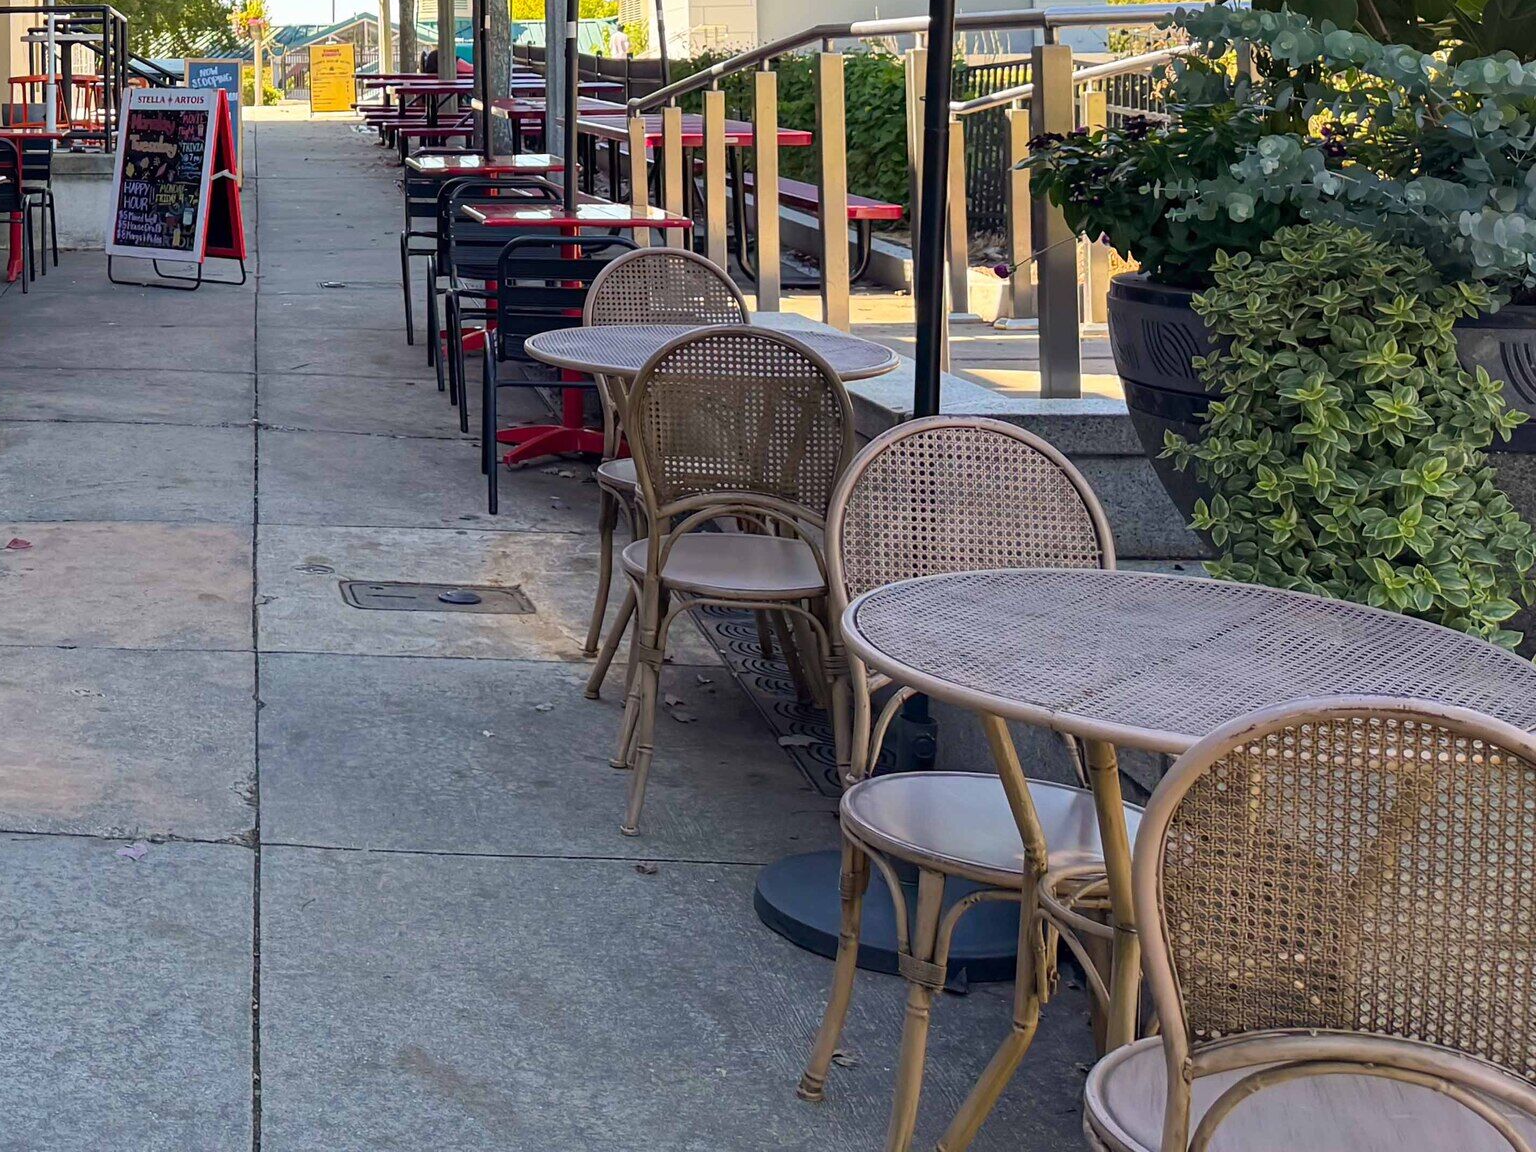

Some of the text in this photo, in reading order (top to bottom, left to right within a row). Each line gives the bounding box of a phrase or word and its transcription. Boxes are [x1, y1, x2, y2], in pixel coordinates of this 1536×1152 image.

[138, 96, 205, 104] STELLA ARTOIS
[124, 181, 151, 195] HAPPY
[124, 196, 149, 211] HOUR
